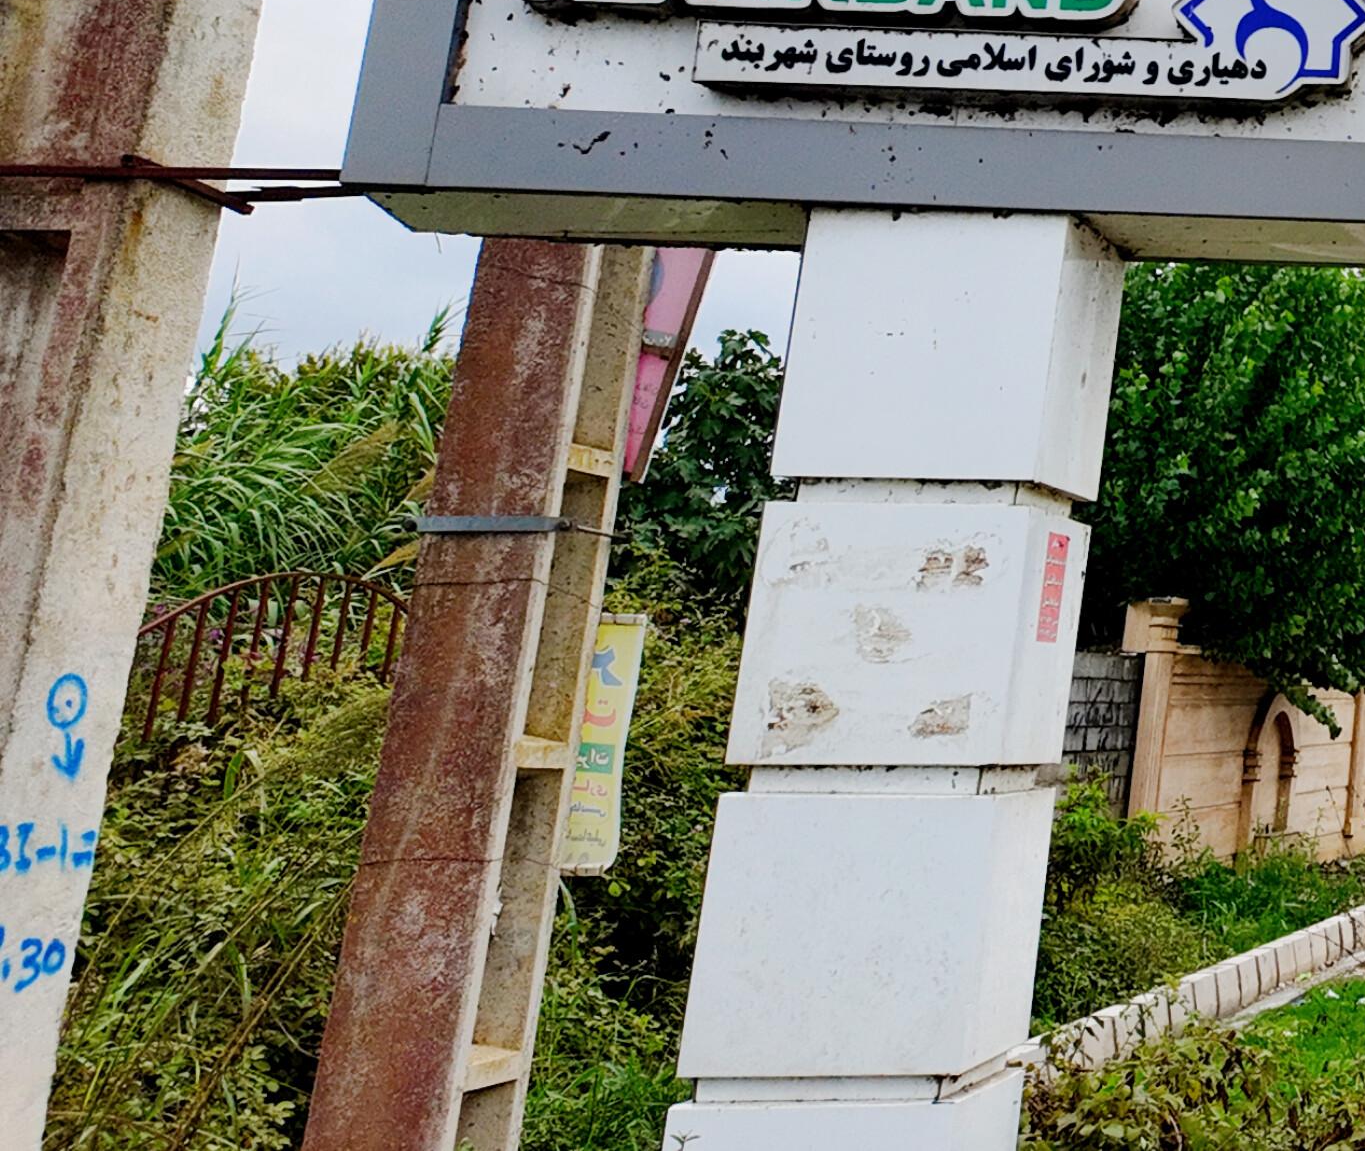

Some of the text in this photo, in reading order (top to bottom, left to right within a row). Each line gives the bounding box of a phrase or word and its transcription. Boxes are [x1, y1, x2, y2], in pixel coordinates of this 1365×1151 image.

[720, 33, 1266, 86] دهیاری و شورای اسلامی روستای شهربند
